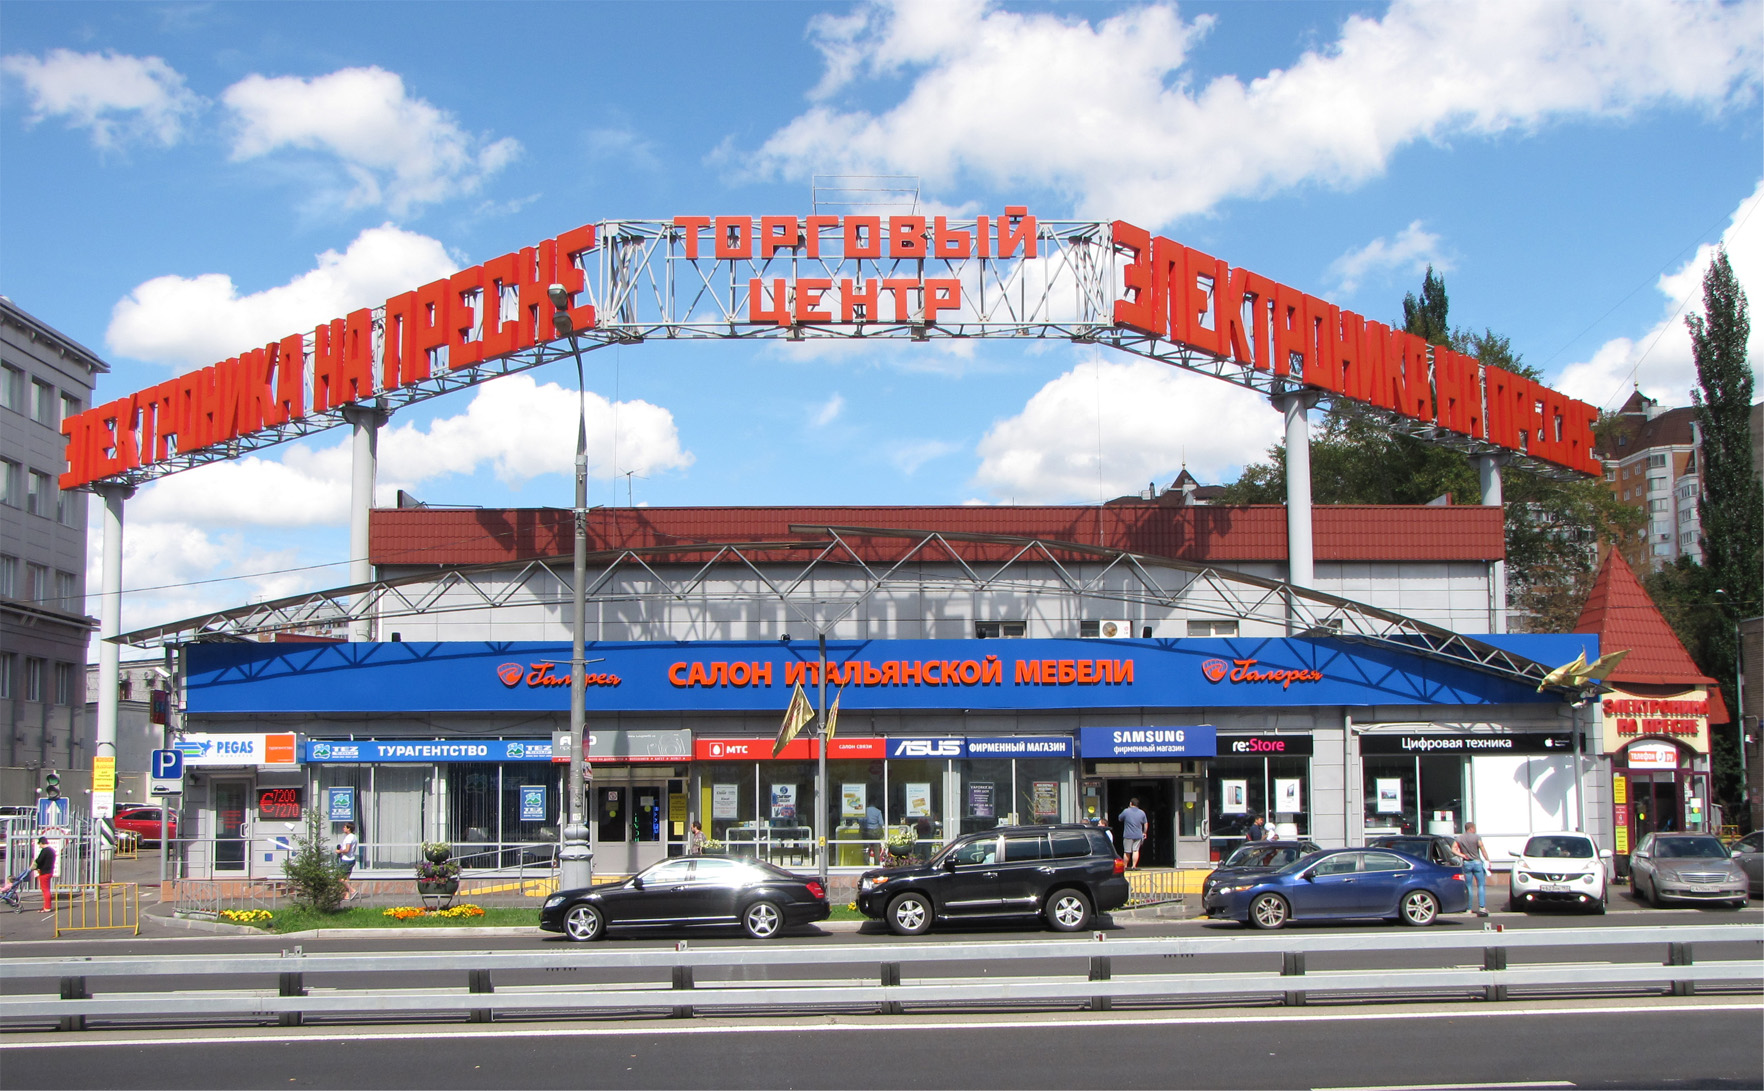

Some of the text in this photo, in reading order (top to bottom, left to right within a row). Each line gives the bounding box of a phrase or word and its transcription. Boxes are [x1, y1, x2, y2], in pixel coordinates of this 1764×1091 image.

[674, 205, 1037, 260] ТОРГОВЫЙ
[749, 278, 961, 327] ЦЕНТР
[1112, 220, 1603, 478] ЭЛЕКТРОНИКА НА ПРЕСНЕ
[59, 224, 596, 490] ЭЛЕКТРОНИКА НА ПРЕСНЕ
[526, 662, 622, 689] Галрея
[668, 655, 1134, 686] САЛОН ИТАЛЬЯНСКОЙ МЕБЕЛИ
[1230, 659, 1323, 688] Галерея
[1602, 699, 1709, 717] ЭЛЕКТРОНИКА
[1617, 719, 1699, 735] НА ПРЕСНЕ
[1113, 730, 1185, 743] SAMSUNG
[1401, 737, 1512, 751] Цифровая техника
[217, 741, 254, 754] PEGAS
[377, 745, 487, 757] ТУРАГЕНТСТВО
[726, 745, 748, 754] МТС
[894, 741, 961, 756] ASUS
[969, 741, 1066, 752] ФИРМЕННЫЙ МАГАЗИН
[1114, 744, 1155, 754] фирменный
[1232, 738, 1285, 751] re:Store
[159, 752, 176, 777] P
[273, 789, 296, 802] 7200
[274, 803, 299, 818] 7270
